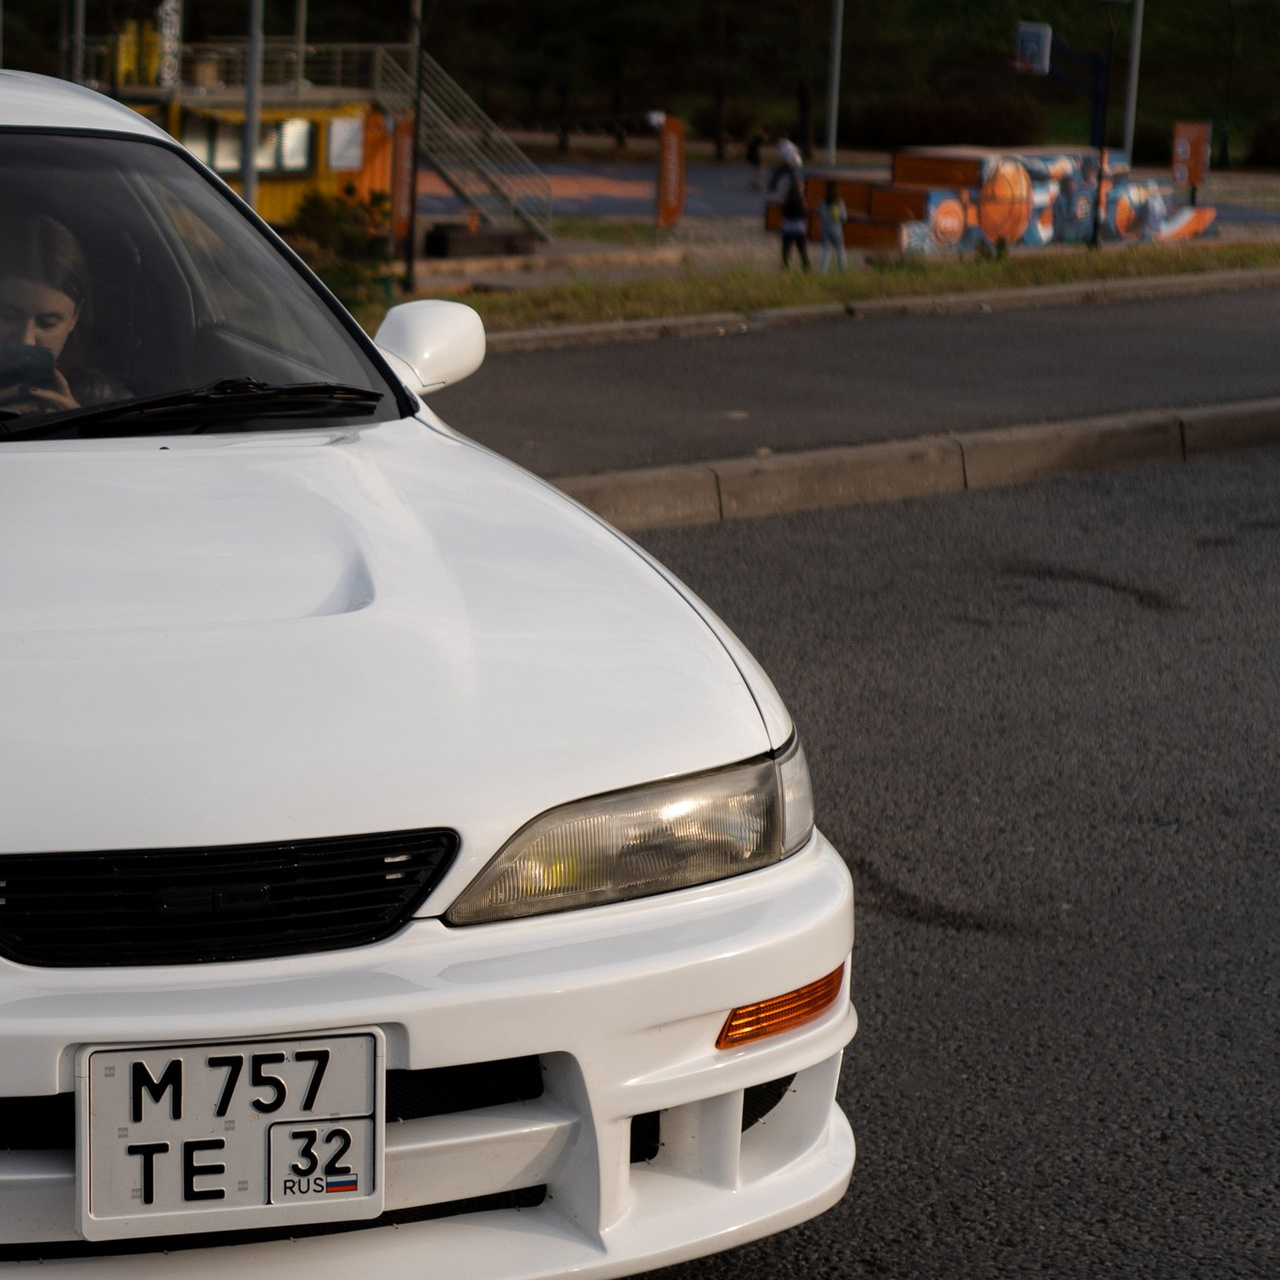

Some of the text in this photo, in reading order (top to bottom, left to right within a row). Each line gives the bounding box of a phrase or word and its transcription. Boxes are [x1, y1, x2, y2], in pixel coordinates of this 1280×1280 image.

[131, 1049, 331, 1123] M 757
[127, 1137, 226, 1205] TE
[290, 1127, 352, 1177] 32
[283, 1176, 325, 1196] RUS
